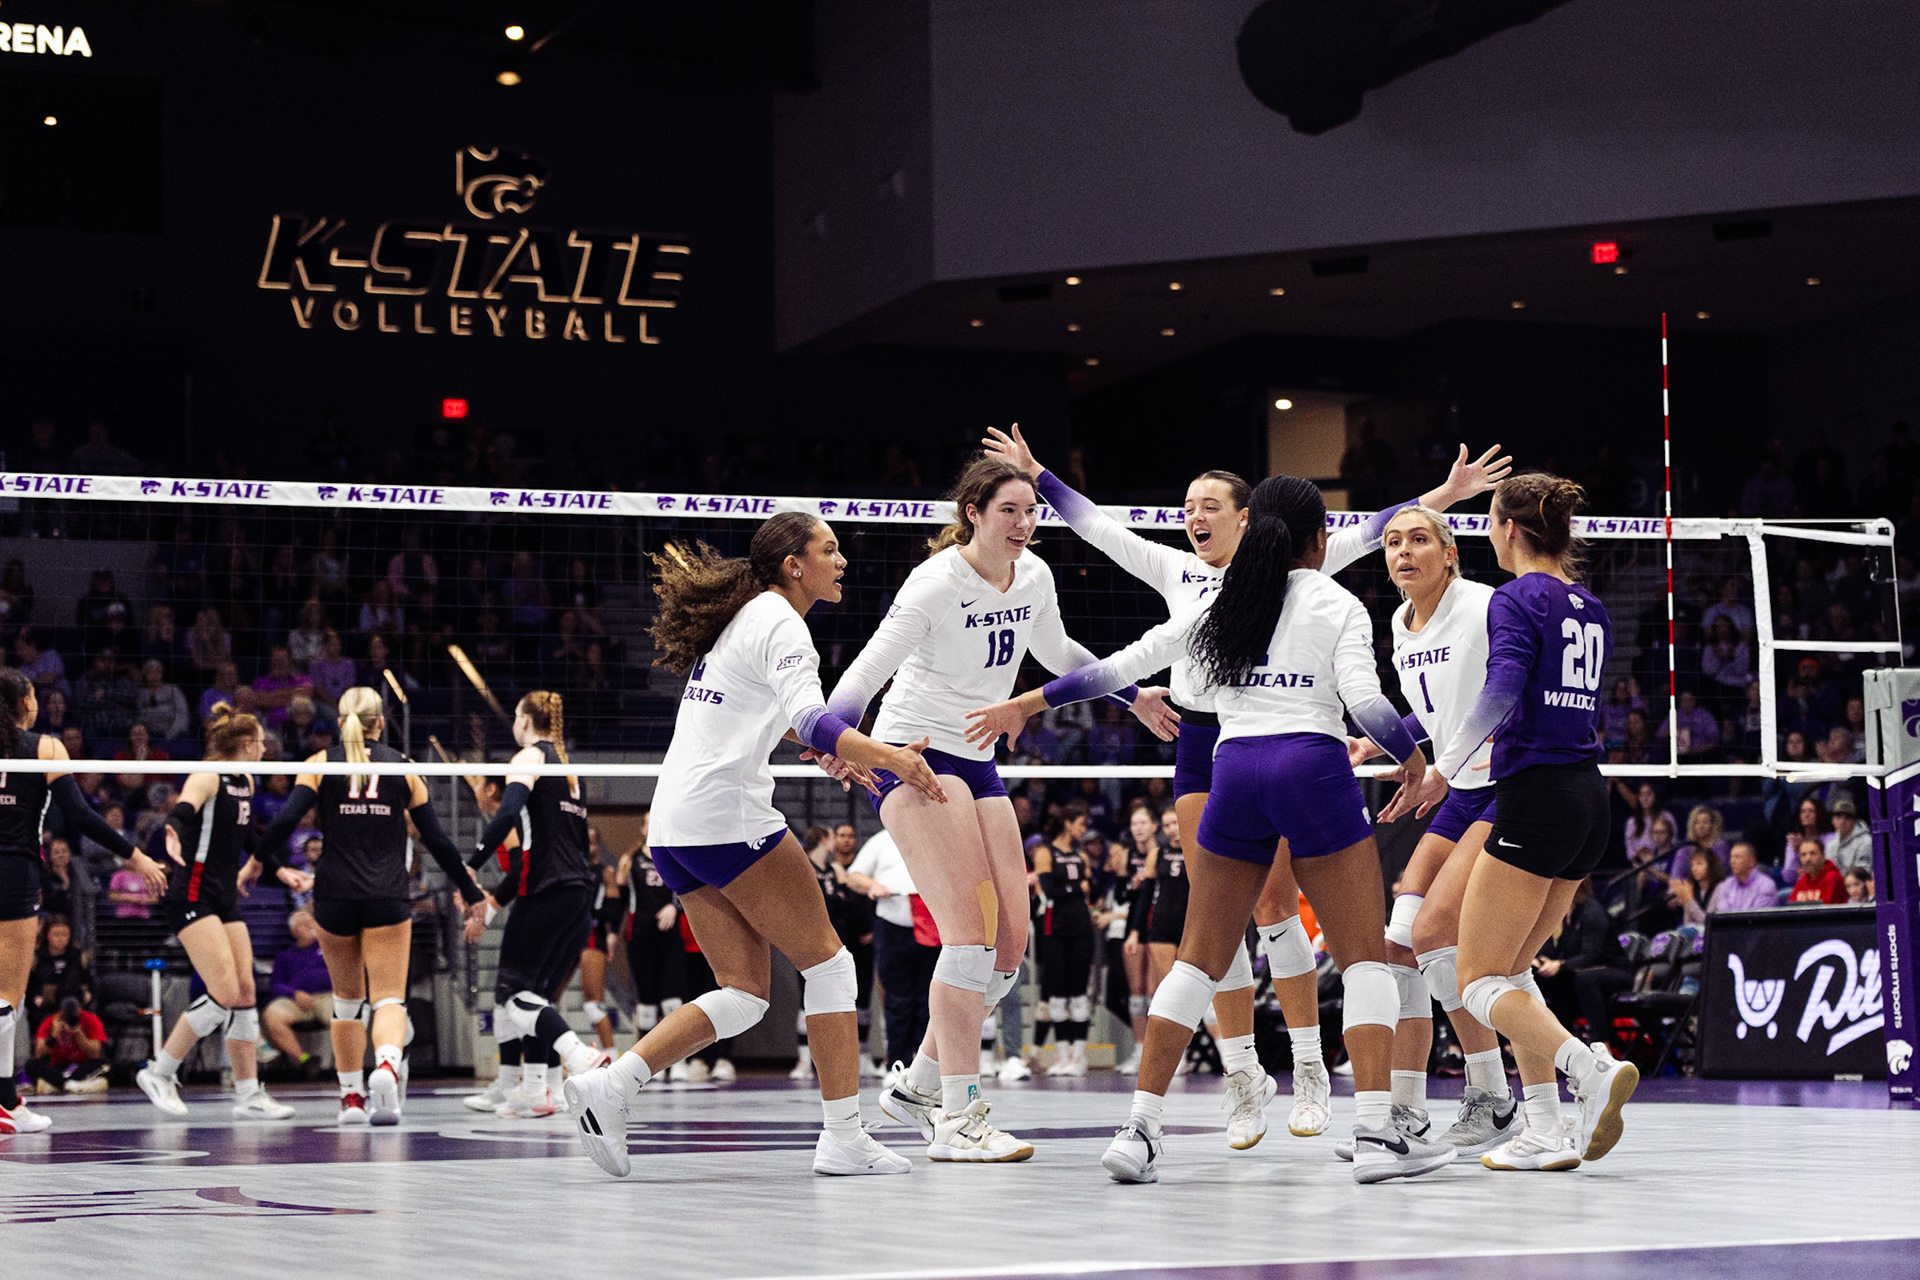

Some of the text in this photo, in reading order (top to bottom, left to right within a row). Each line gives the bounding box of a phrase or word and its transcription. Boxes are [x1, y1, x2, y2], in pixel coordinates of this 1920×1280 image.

[257, 214, 691, 309] K-STATE
[291, 296, 660, 344] VOLLEYBALL
[171, 481, 271, 499] K-STATE
[347, 486, 445, 505] K-STATE
[518, 491, 613, 509] K-STATE
[684, 496, 776, 514] K-STATE
[846, 501, 935, 518] K-STATE
[1586, 519, 1664, 533] K-STATE
[965, 605, 1032, 628] K-STATE
[984, 629, 1015, 668] 18
[1400, 646, 1451, 671] K-STATE
[1561, 617, 1604, 691] 20
[1419, 672, 1435, 713] 1
[339, 804, 391, 816] TEXAS TECH
[1888, 924, 1903, 1029] sports imports
